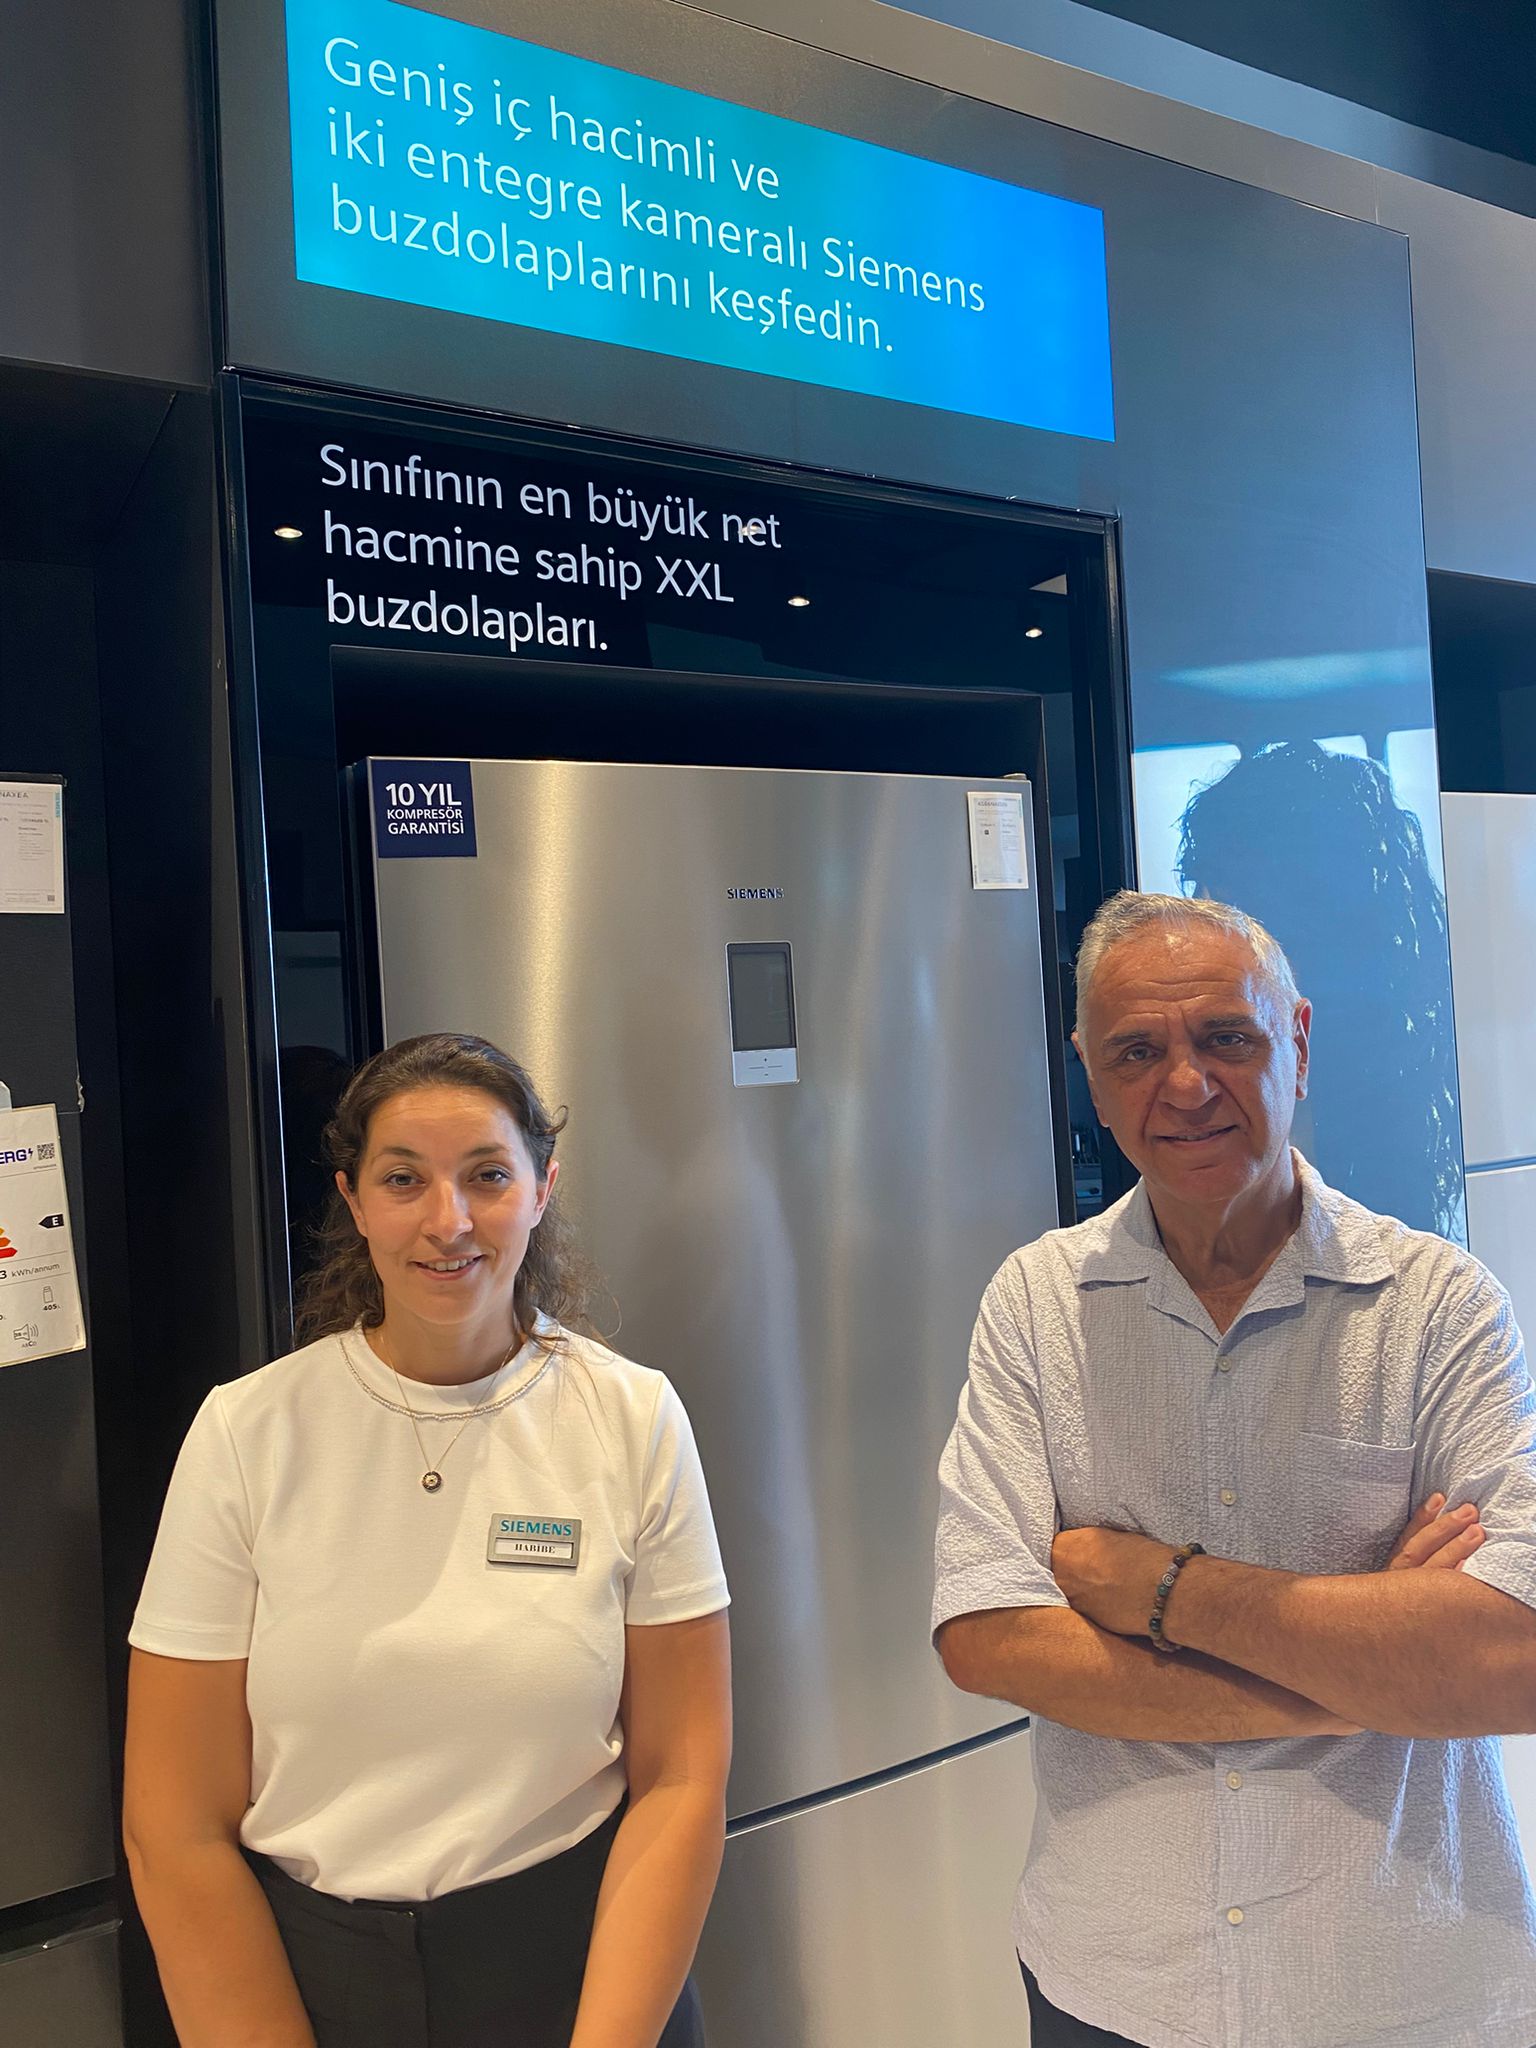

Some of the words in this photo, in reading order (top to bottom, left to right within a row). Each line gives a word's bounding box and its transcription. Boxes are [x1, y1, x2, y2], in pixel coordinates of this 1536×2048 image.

[324, 37, 474, 126] Geniş
[493, 80, 532, 141] iç
[549, 96, 715, 183] hacimli
[731, 159, 780, 199] ve
[328, 107, 385, 167] iki
[407, 143, 602, 220] entegre
[620, 183, 807, 271] kameralı
[822, 237, 985, 312] Siemens
[332, 182, 690, 309] buzdolaplarını
[709, 271, 893, 352] keşfedin.
[320, 444, 503, 509] Sınıfının
[519, 483, 572, 519] en
[587, 482, 710, 542] büyük
[722, 513, 782, 549] net
[324, 510, 520, 576] hacmine
[535, 544, 642, 601] sahip
[655, 556, 735, 603] XXL
[326, 578, 608, 653] buzdolapları.
[385, 783, 415, 806] 10
[418, 783, 462, 806] YIL
[387, 806, 463, 820] KOMPRESÖR
[388, 819, 465, 835] GARANTİSİ
[727, 888, 785, 900] SIEMENS
[52, 1217, 60, 1226] E
[12, 1263, 61, 1278] kWh/annum
[500, 1519, 573, 1537] SIEMENS
